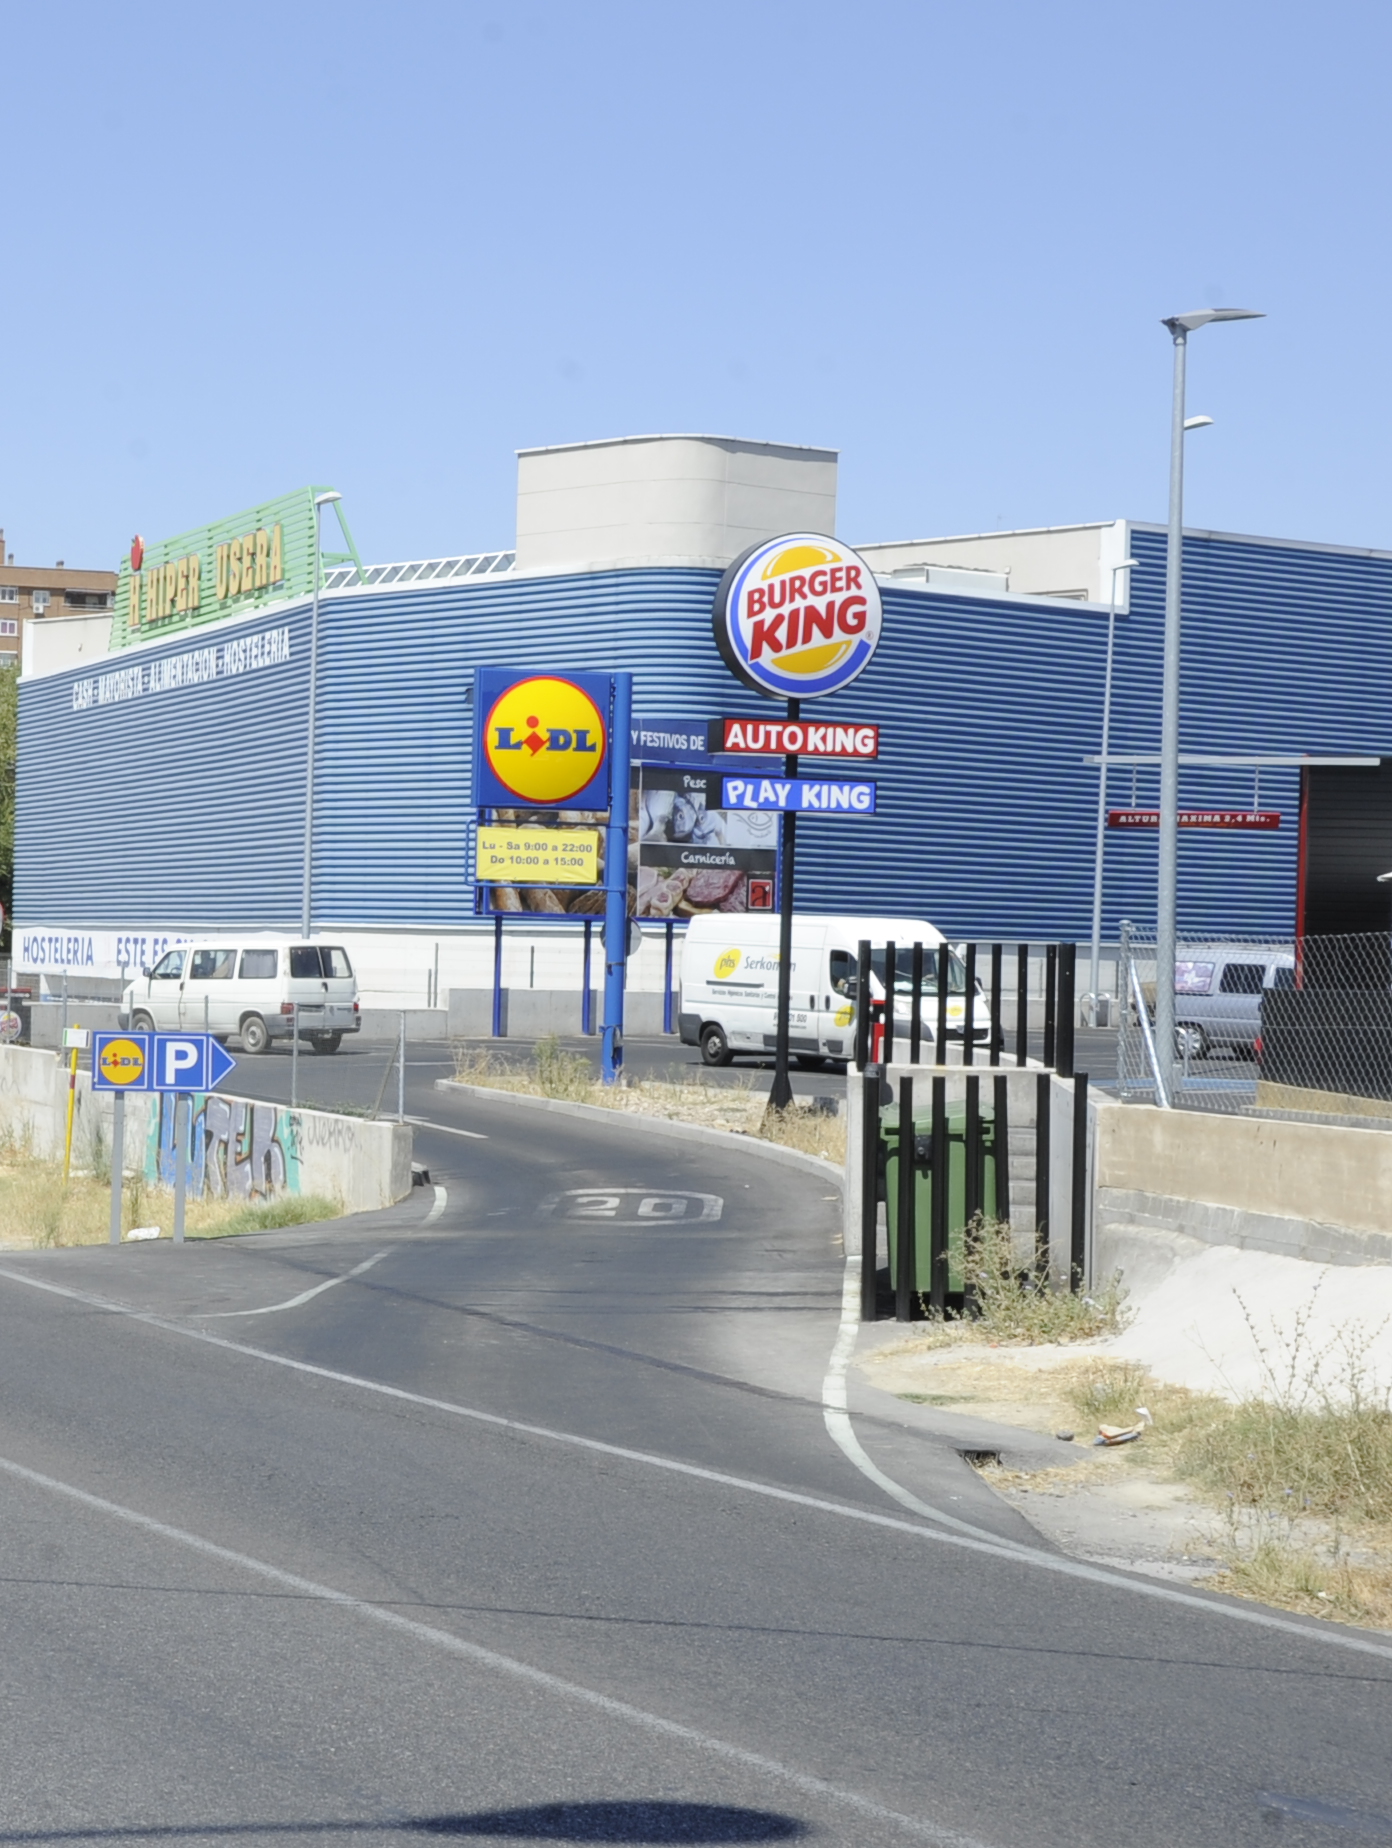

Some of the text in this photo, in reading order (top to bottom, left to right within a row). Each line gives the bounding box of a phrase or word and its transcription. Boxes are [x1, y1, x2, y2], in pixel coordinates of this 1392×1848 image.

[146, 554, 200, 623] HIPER
[215, 523, 283, 600] USERA
[746, 564, 862, 619] BURGER
[748, 595, 868, 662] KING
[72, 626, 290, 711] CASH MAYORISTA ALIMENTACION HOSTELERIA
[640, 731, 687, 750] FESTIVOS
[690, 736, 705, 751] DE
[725, 723, 875, 754] AUTO KING
[726, 779, 871, 810] PLAY KING
[1118, 815, 1161, 823] ALTUR
[1177, 815, 1221, 823] AXIMA
[482, 841, 496, 850] Lu
[506, 841, 520, 850] Sa
[524, 842, 548, 851] 9:00
[551, 844, 559, 852] a
[562, 843, 593, 853] 22:00
[490, 855, 505, 864] Do
[509, 856, 539, 865] 10:00
[554, 857, 584, 867] 15:00
[681, 851, 736, 866] Carnicería
[23, 936, 95, 967] HOSTELERIA
[116, 937, 146, 968] ESTE
[719, 954, 796, 972] phs Serkonn
[165, 1041, 198, 1084] P
[570, 1196, 688, 1218] 20
